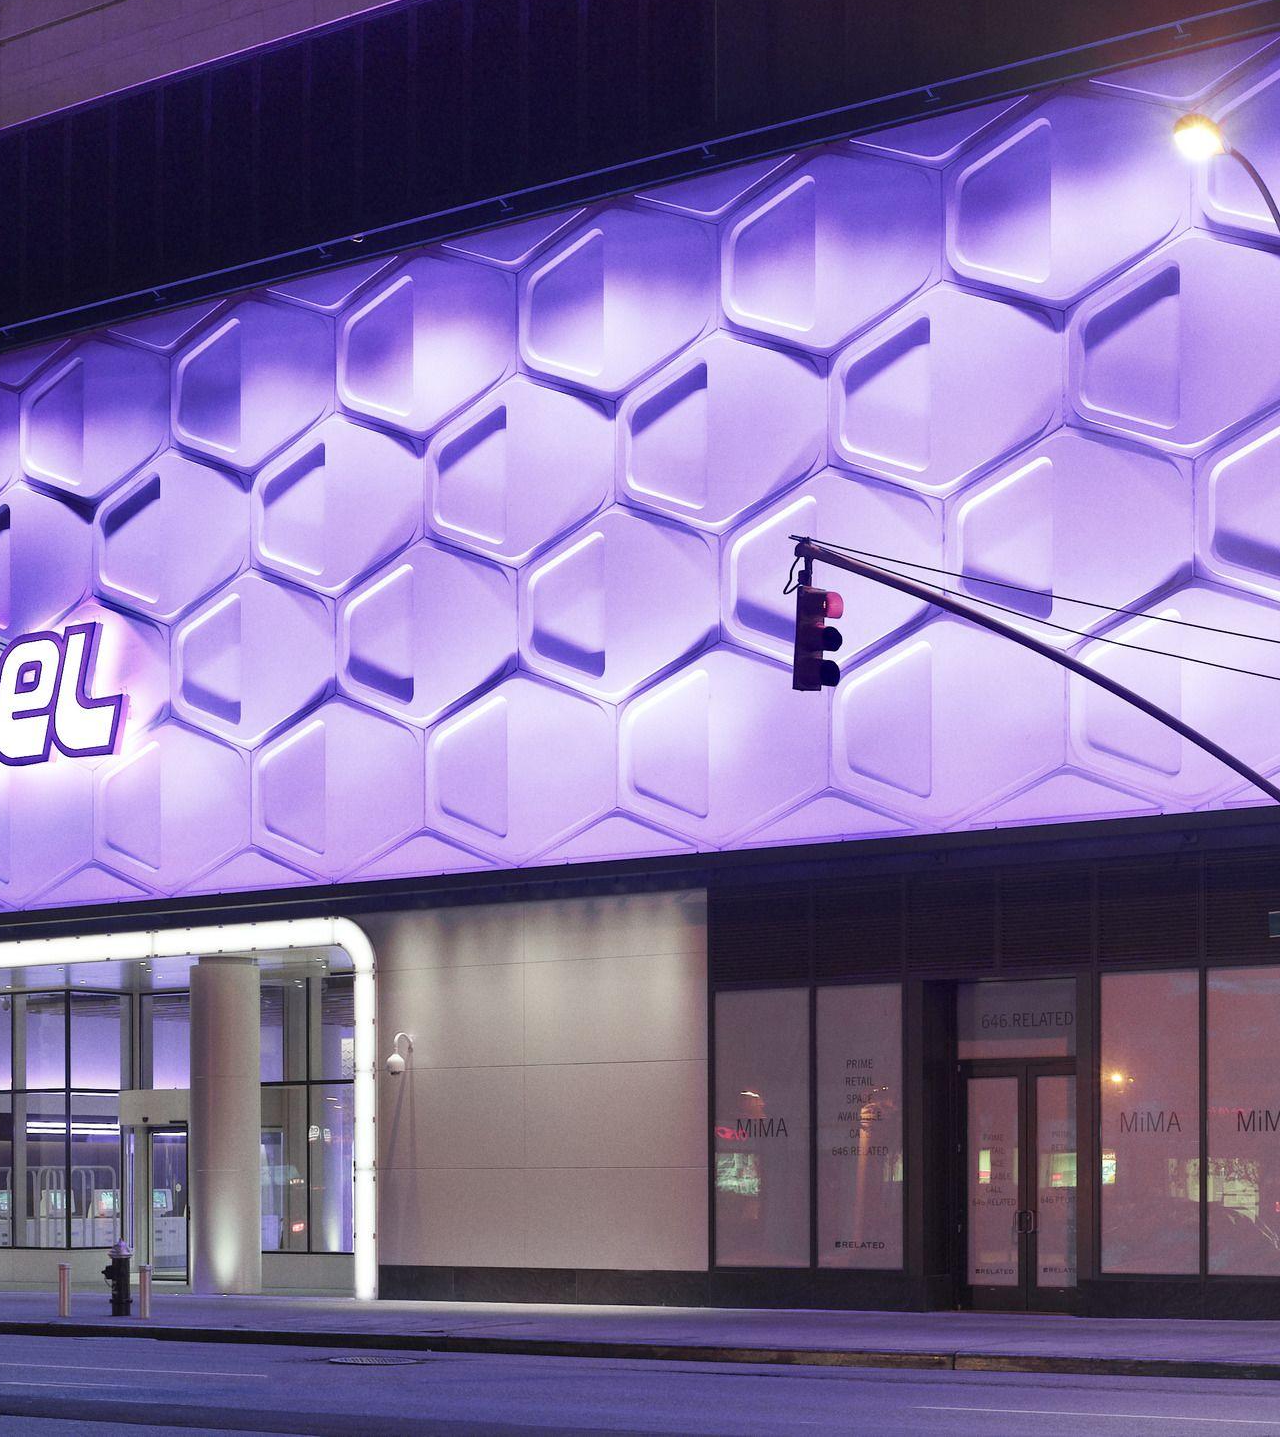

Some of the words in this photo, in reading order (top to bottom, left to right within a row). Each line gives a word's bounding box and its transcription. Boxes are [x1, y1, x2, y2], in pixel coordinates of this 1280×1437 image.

[846, 1059, 873, 1069] PRIME
[845, 1076, 875, 1086] RETAIL
[838, 1111, 883, 1121] AVAILE
[1120, 1111, 1182, 1133] MiMA
[736, 1118, 788, 1138] MiMA
[841, 1241, 885, 1249] RELATED
